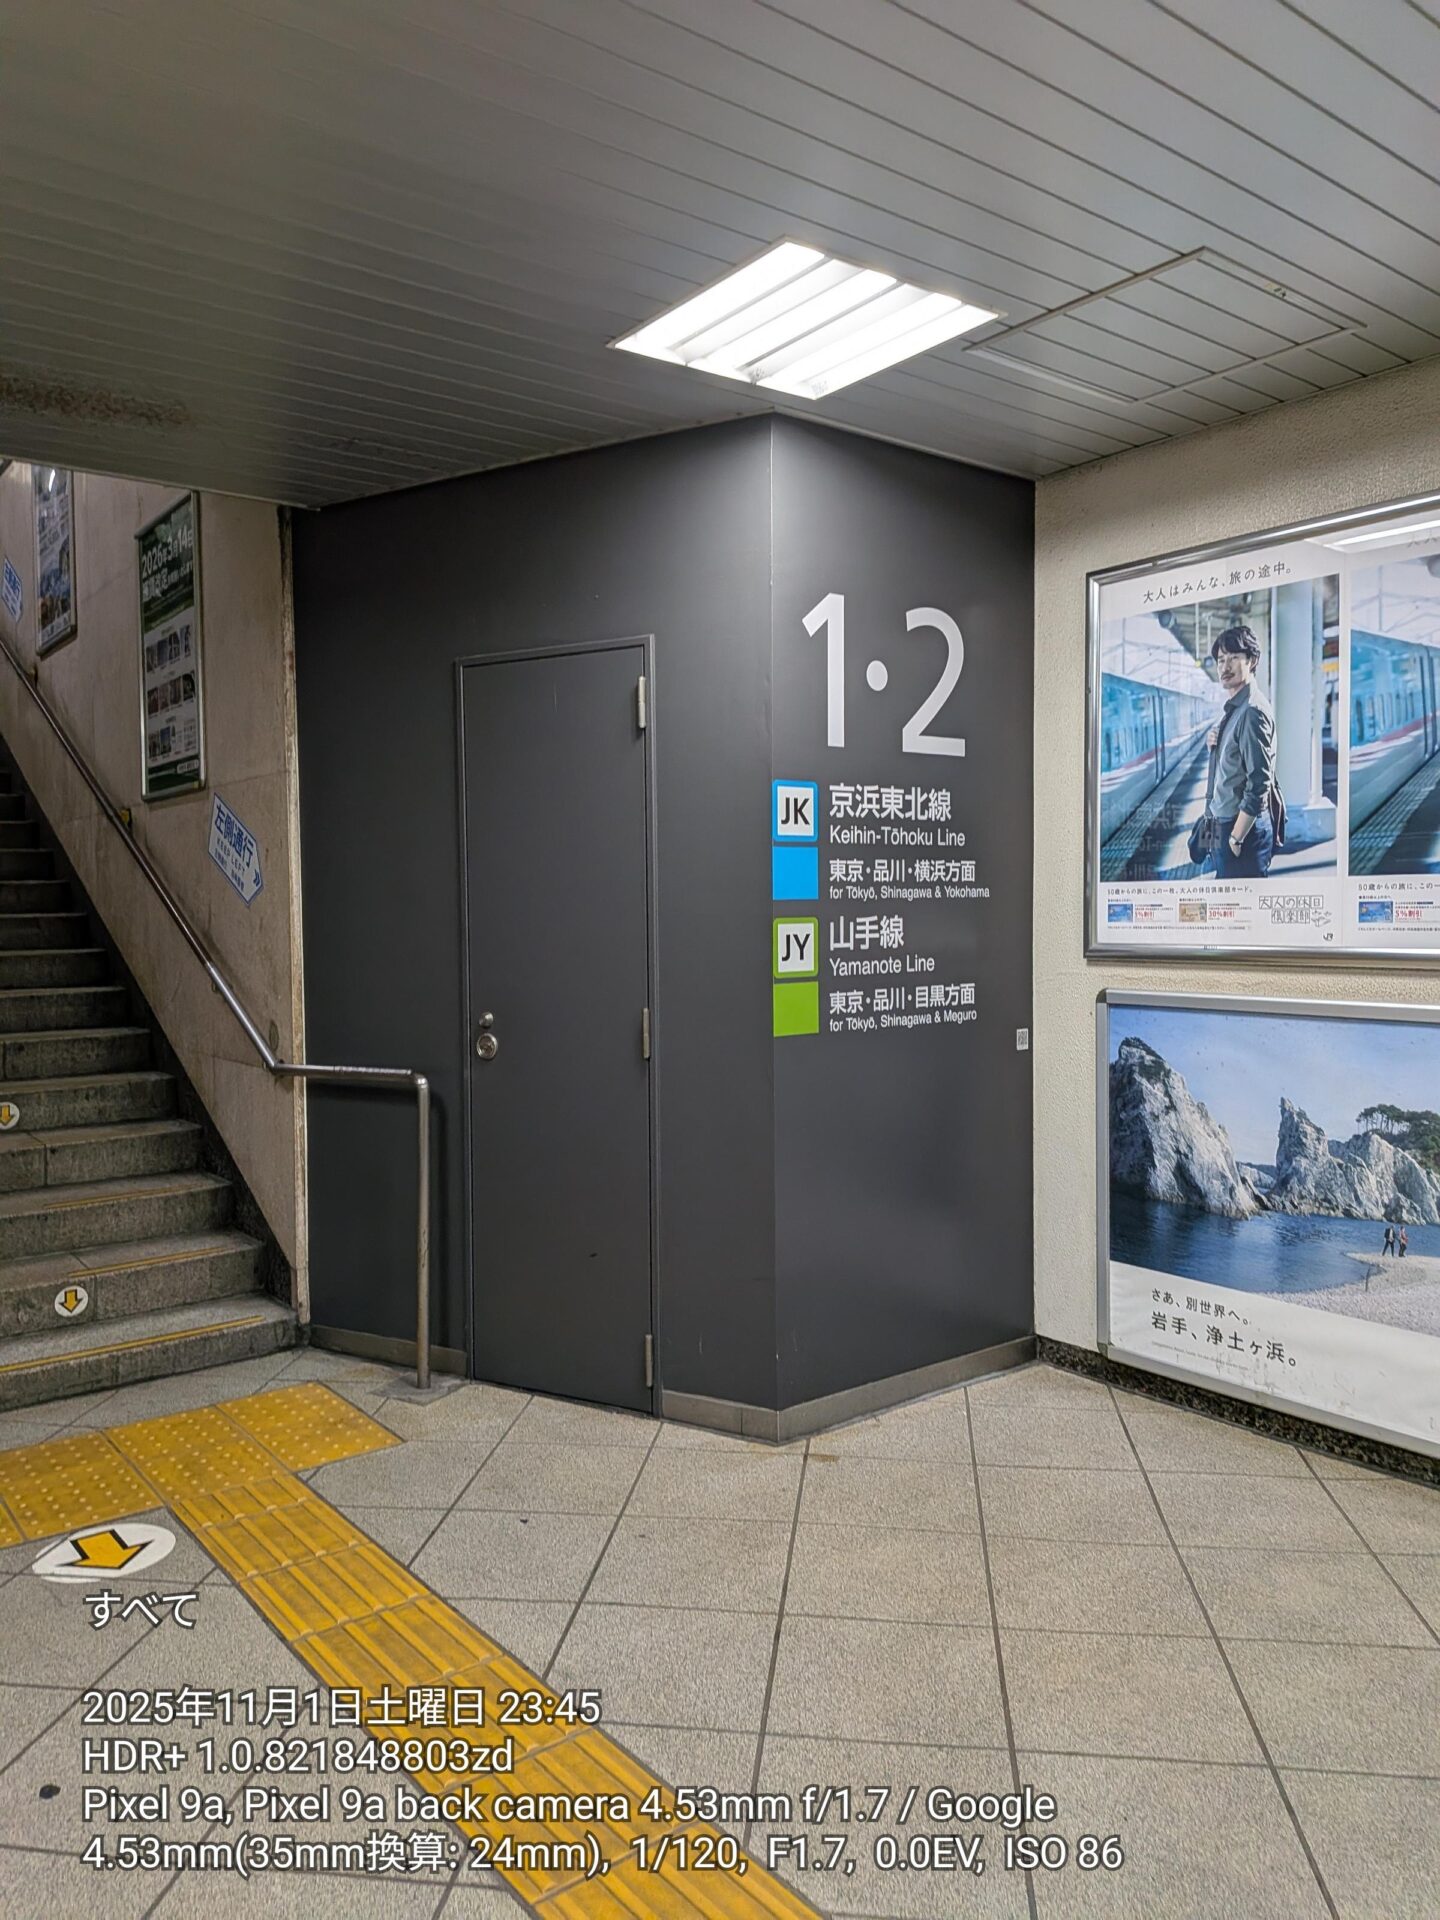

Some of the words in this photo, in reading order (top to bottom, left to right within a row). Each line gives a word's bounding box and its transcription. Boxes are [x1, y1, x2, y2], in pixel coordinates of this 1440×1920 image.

[1143, 561, 1294, 603] 大人はみんな、旅の途中。
[780, 796, 810, 826] JK
[829, 783, 952, 822] 京浜東北線
[214, 803, 255, 868] 左側通行
[829, 825, 933, 846] Keihin-Tōhoku
[937, 828, 966, 847] Line
[216, 837, 231, 857] KEEP
[231, 854, 246, 874] LEFT
[829, 859, 976, 883] 東京・品川・横浜方面
[829, 886, 844, 900] for
[880, 886, 932, 901] Shinagawa
[934, 886, 942, 898] &
[944, 886, 990, 898] Yokohama
[1260, 895, 1322, 909] 大人の休日
[781, 933, 811, 962] JY
[829, 915, 904, 951] 山手線
[829, 956, 902, 977] Yamanote
[906, 954, 935, 973] Line
[829, 983, 976, 1015] 東京・品川・目黒方面
[829, 1018, 844, 1032] for
[880, 1012, 932, 1028] Shinagawa
[934, 1011, 942, 1023] &
[943, 1009, 977, 1024] Meguro
[1152, 1288, 1250, 1326] さあ、別世界へ。
